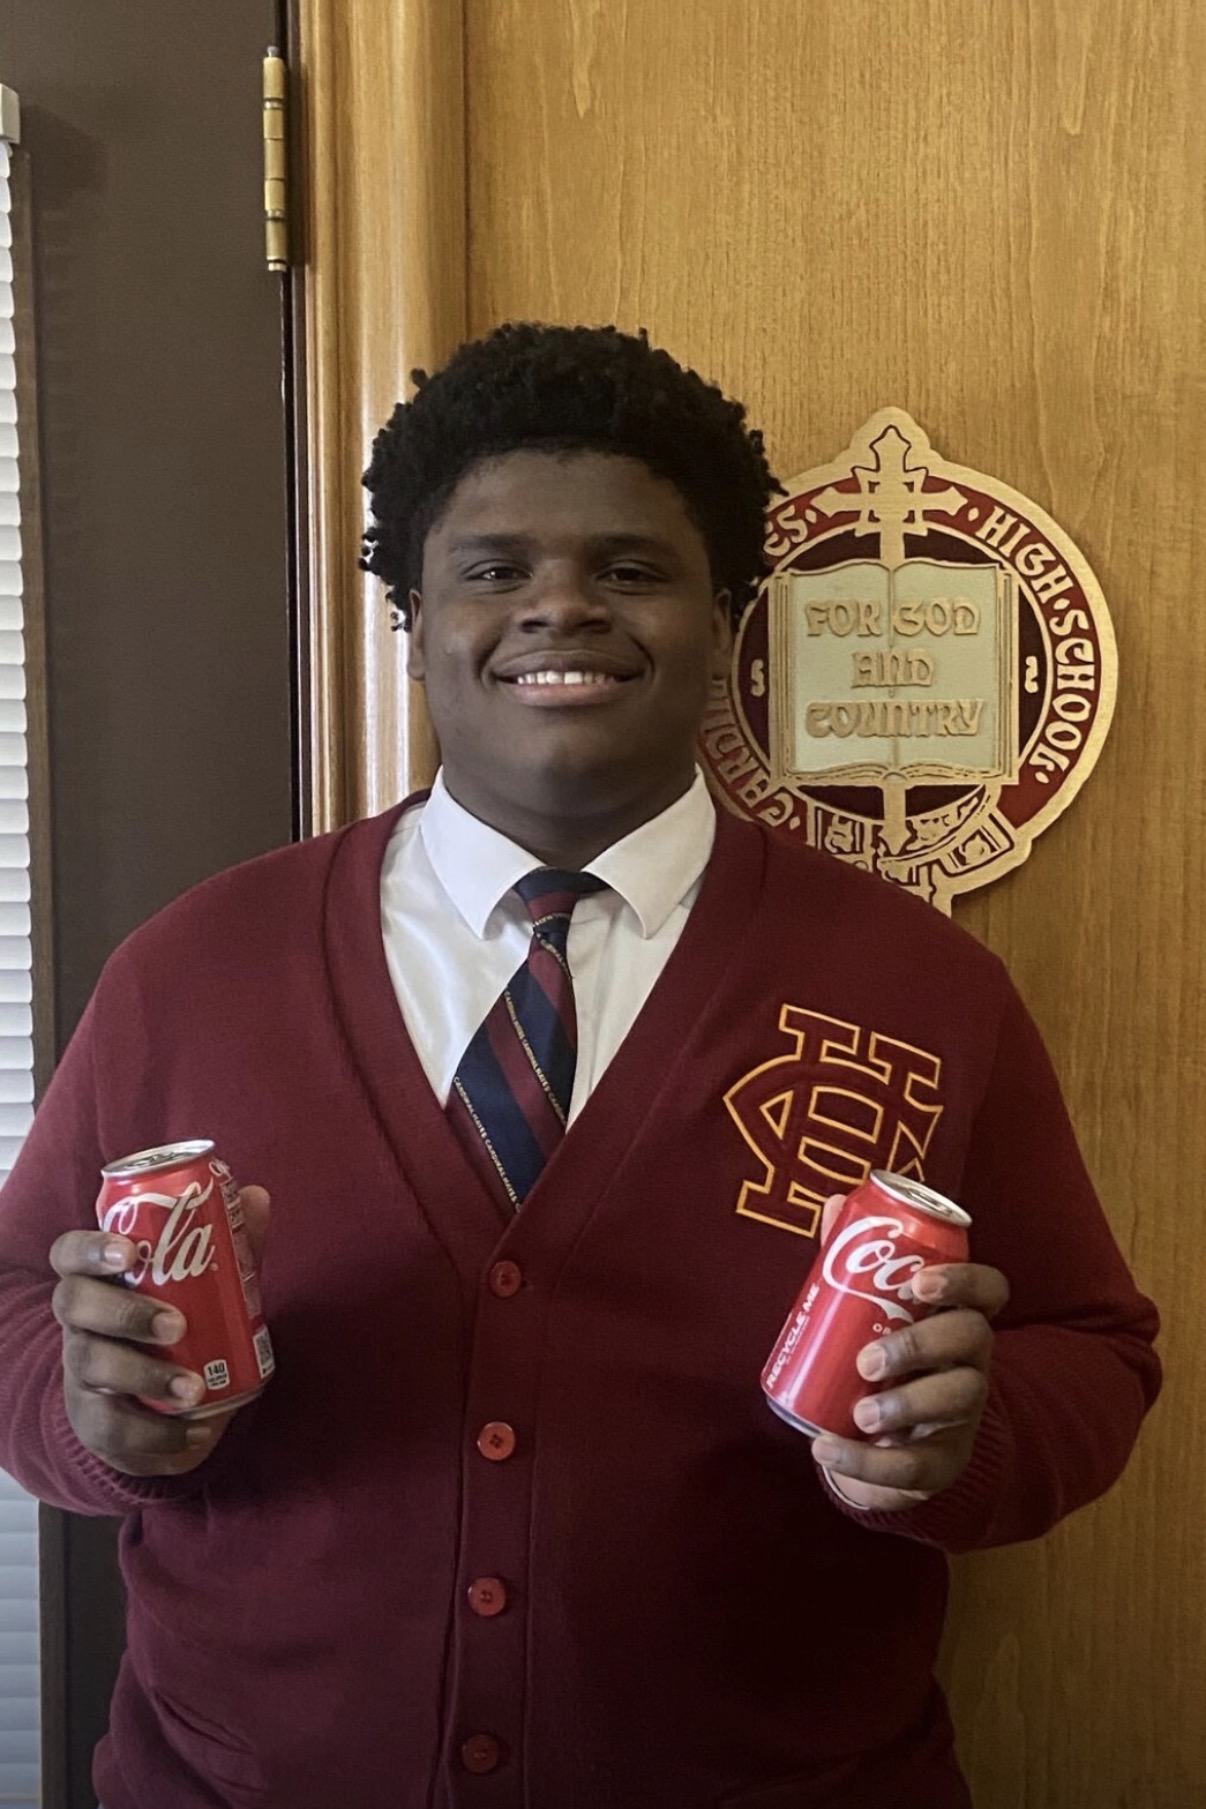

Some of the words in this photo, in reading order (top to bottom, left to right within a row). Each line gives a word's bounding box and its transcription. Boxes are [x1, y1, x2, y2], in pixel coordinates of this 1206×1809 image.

[805, 599, 883, 638] FOR
[893, 597, 981, 638] GOD
[974, 505, 1074, 605] HIGH
[1028, 609, 1095, 773] SCHOOL
[851, 649, 935, 689] AND
[805, 698, 984, 739] COUNTRY
[453, 1076, 475, 1114] CARDINAL
[472, 1112, 488, 1139] HAYES
[485, 1139, 506, 1177] CARDINAL
[503, 1176, 518, 1203] HAYES
[765, 1310, 808, 1389] RECYCLE
[801, 1282, 820, 1313] ME
[207, 1362, 226, 1377] 140
